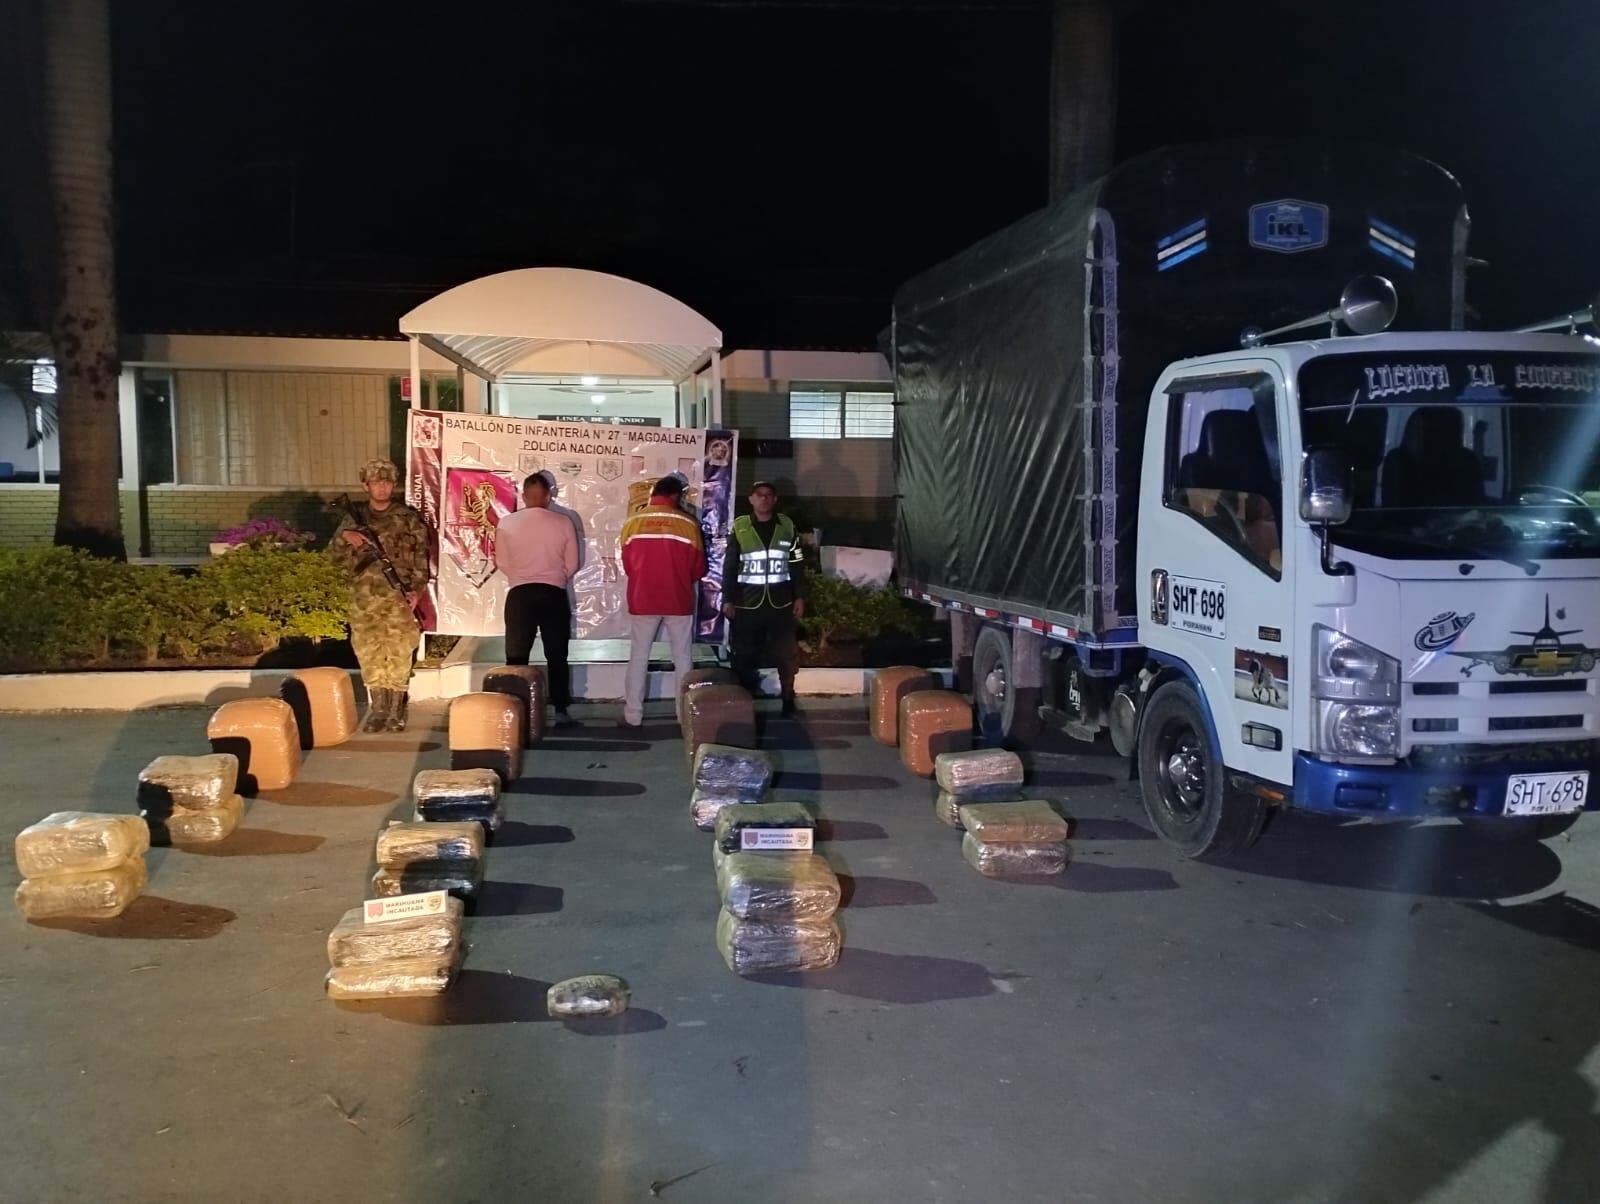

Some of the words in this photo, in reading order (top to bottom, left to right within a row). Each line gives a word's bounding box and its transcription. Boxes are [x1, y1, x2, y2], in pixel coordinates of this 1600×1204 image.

[1467, 364, 1496, 387] LA
[507, 423, 522, 434] DE
[608, 430, 620, 441] 27
[570, 443, 626, 456] NACIONAL
